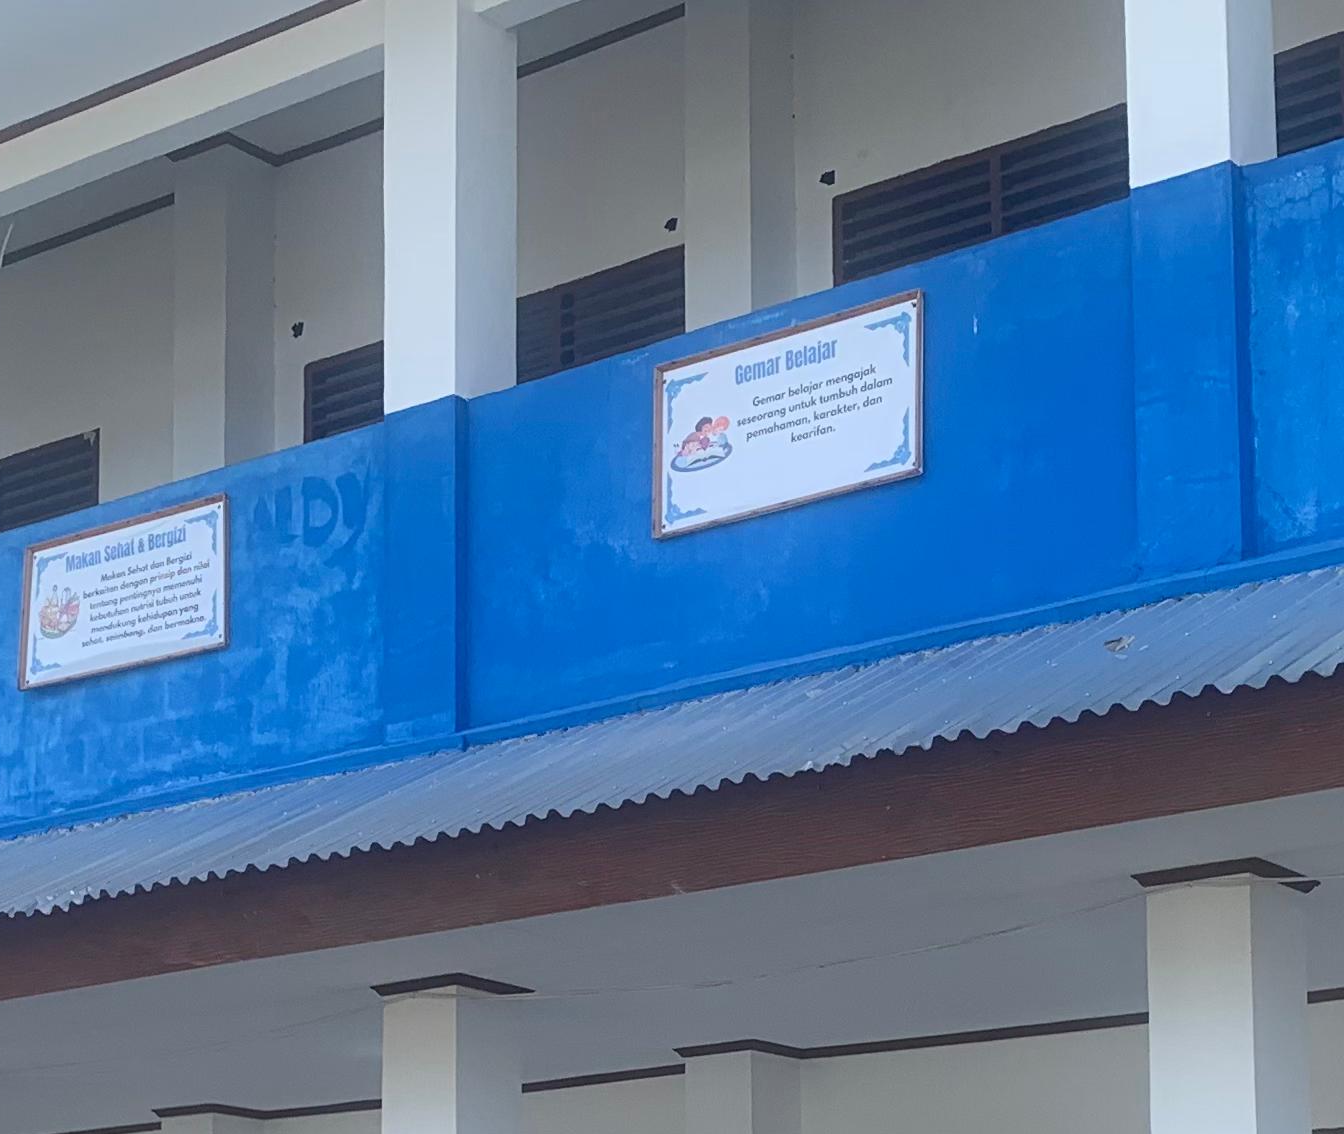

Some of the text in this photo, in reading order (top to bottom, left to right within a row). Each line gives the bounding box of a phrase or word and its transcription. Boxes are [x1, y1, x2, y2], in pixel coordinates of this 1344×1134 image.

[735, 341, 838, 385] Gemar Belajar
[737, 377, 893, 427] seseorang untuk tumbuh dalam
[752, 365, 875, 407] Gemar belajar mengajak
[746, 396, 882, 443] pemahaman, karakter, dan
[791, 424, 836, 443] kearifan.
[65, 526, 186, 573] Makan Sehat & Bergizi
